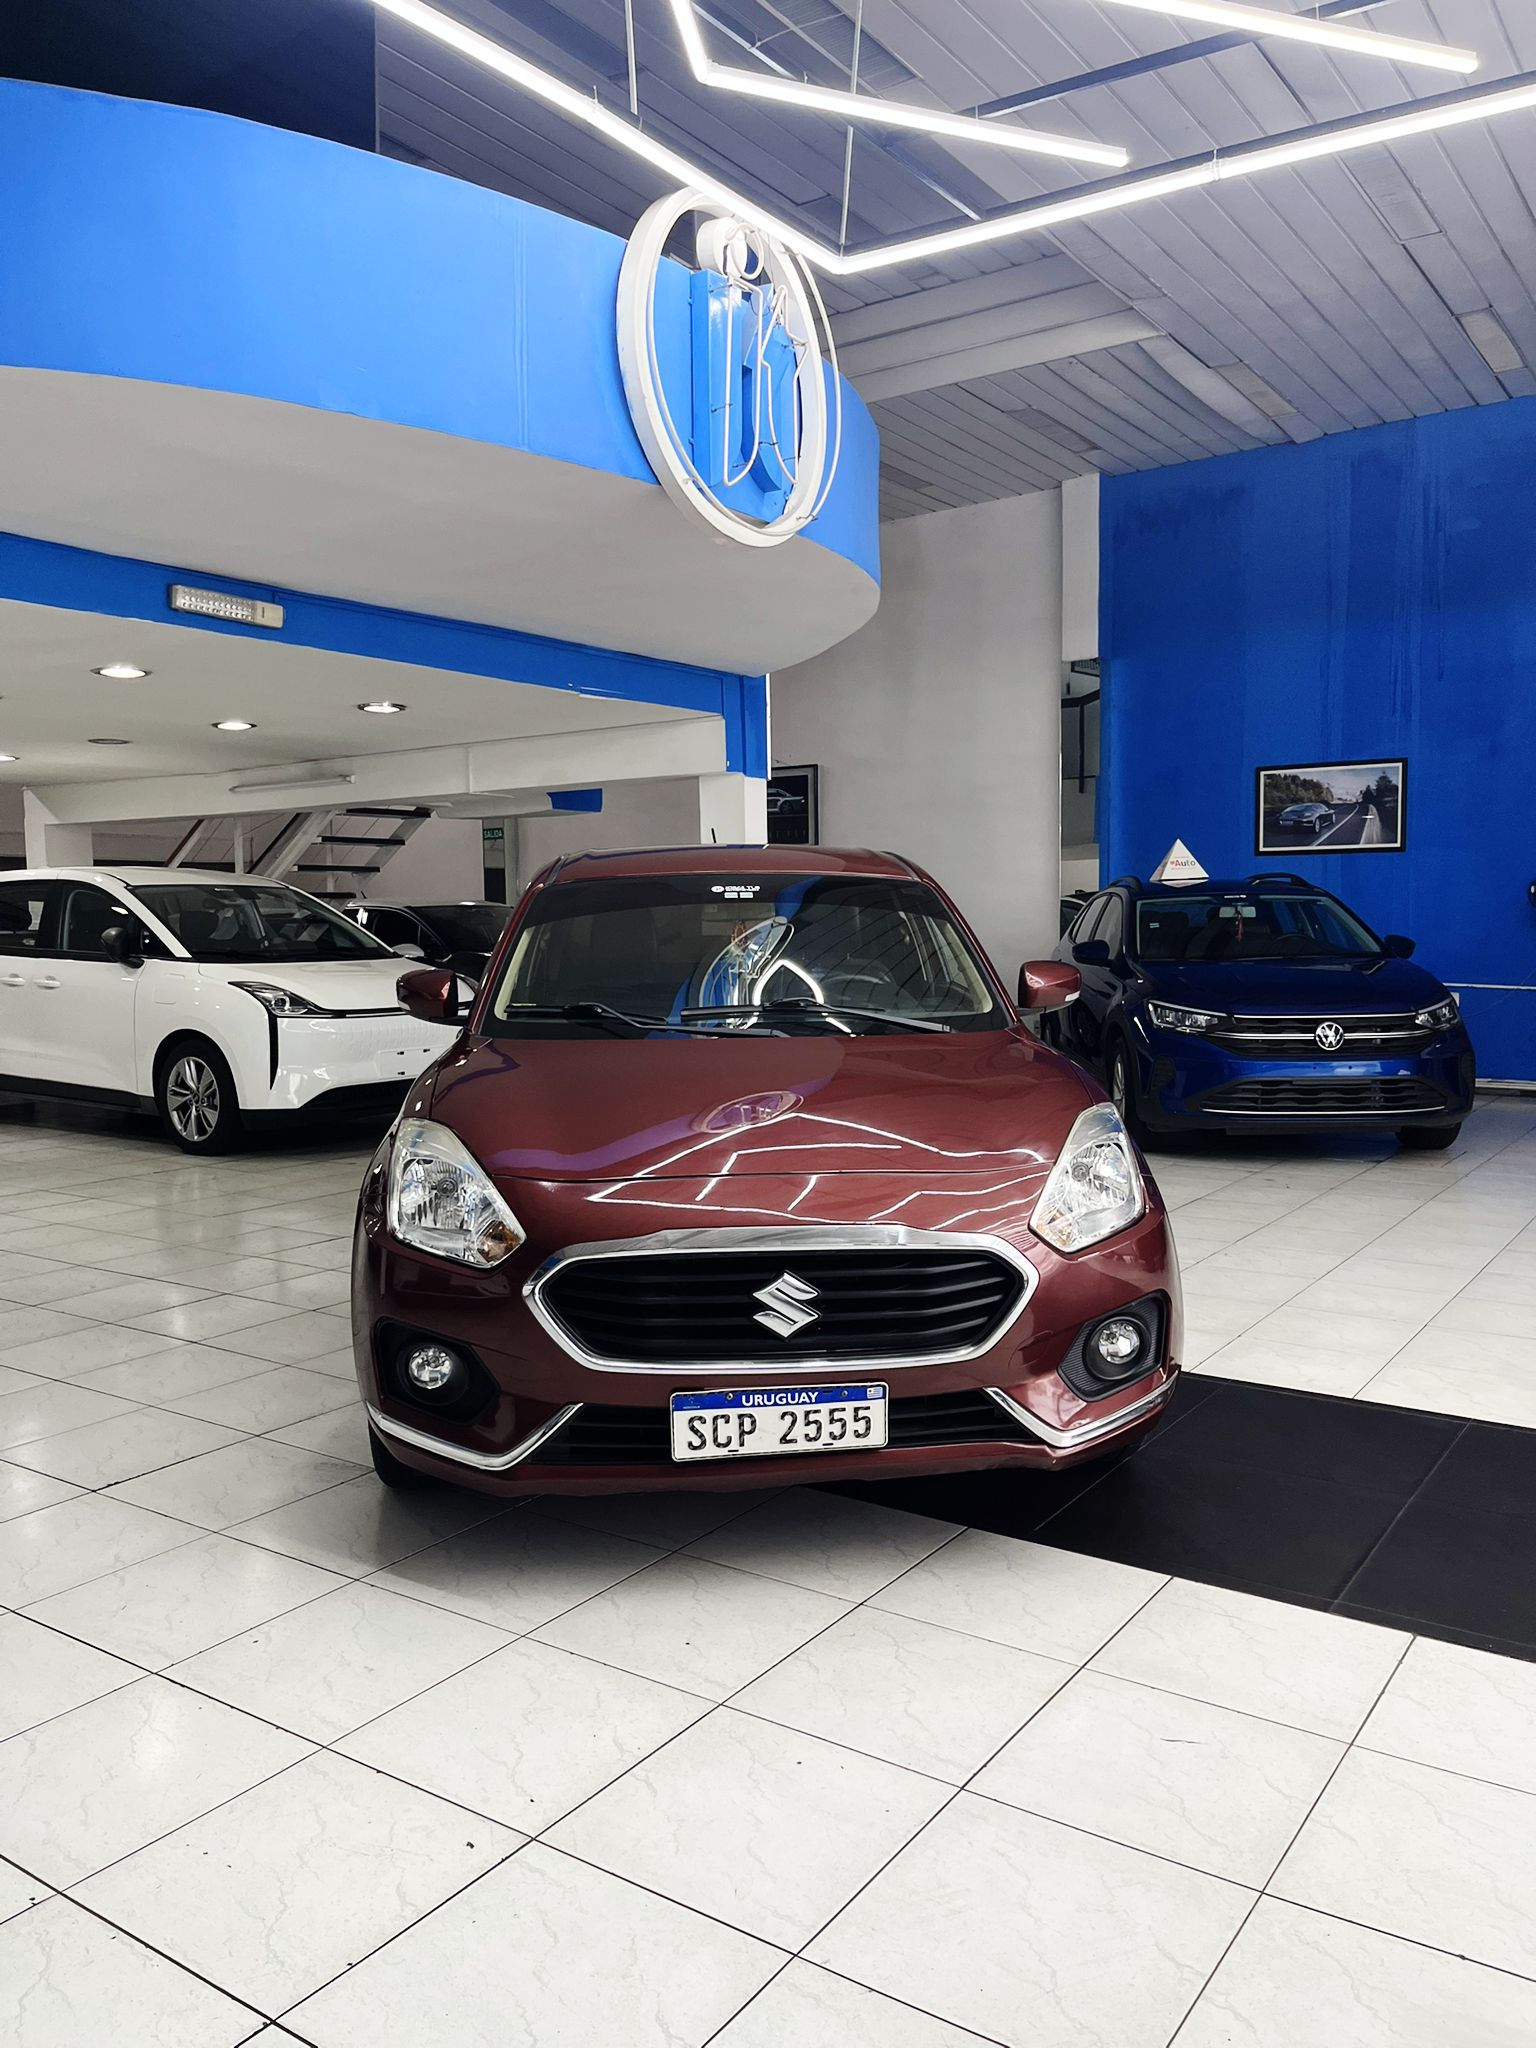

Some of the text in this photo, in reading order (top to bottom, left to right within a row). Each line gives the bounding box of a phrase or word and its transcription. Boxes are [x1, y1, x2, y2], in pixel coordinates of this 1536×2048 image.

[741, 1391, 819, 1407] URUGUAY
[687, 1405, 872, 1451] SCP 2555
